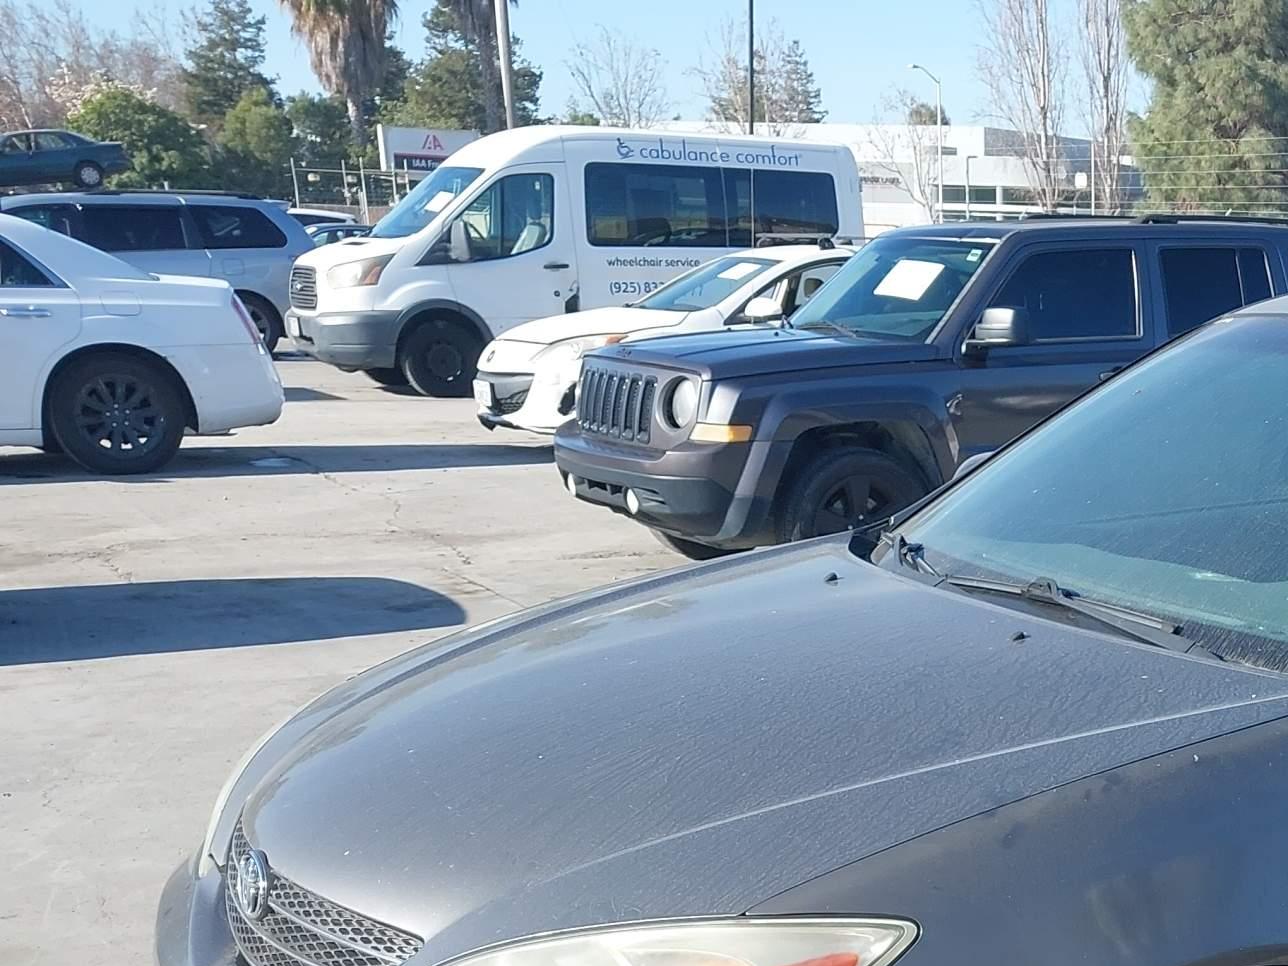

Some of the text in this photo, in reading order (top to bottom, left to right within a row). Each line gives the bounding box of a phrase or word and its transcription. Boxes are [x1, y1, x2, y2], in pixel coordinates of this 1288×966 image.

[639, 138, 799, 166] cabulance comfort
[606, 256, 663, 267] wheelchair
[609, 281, 641, 295] (925)
